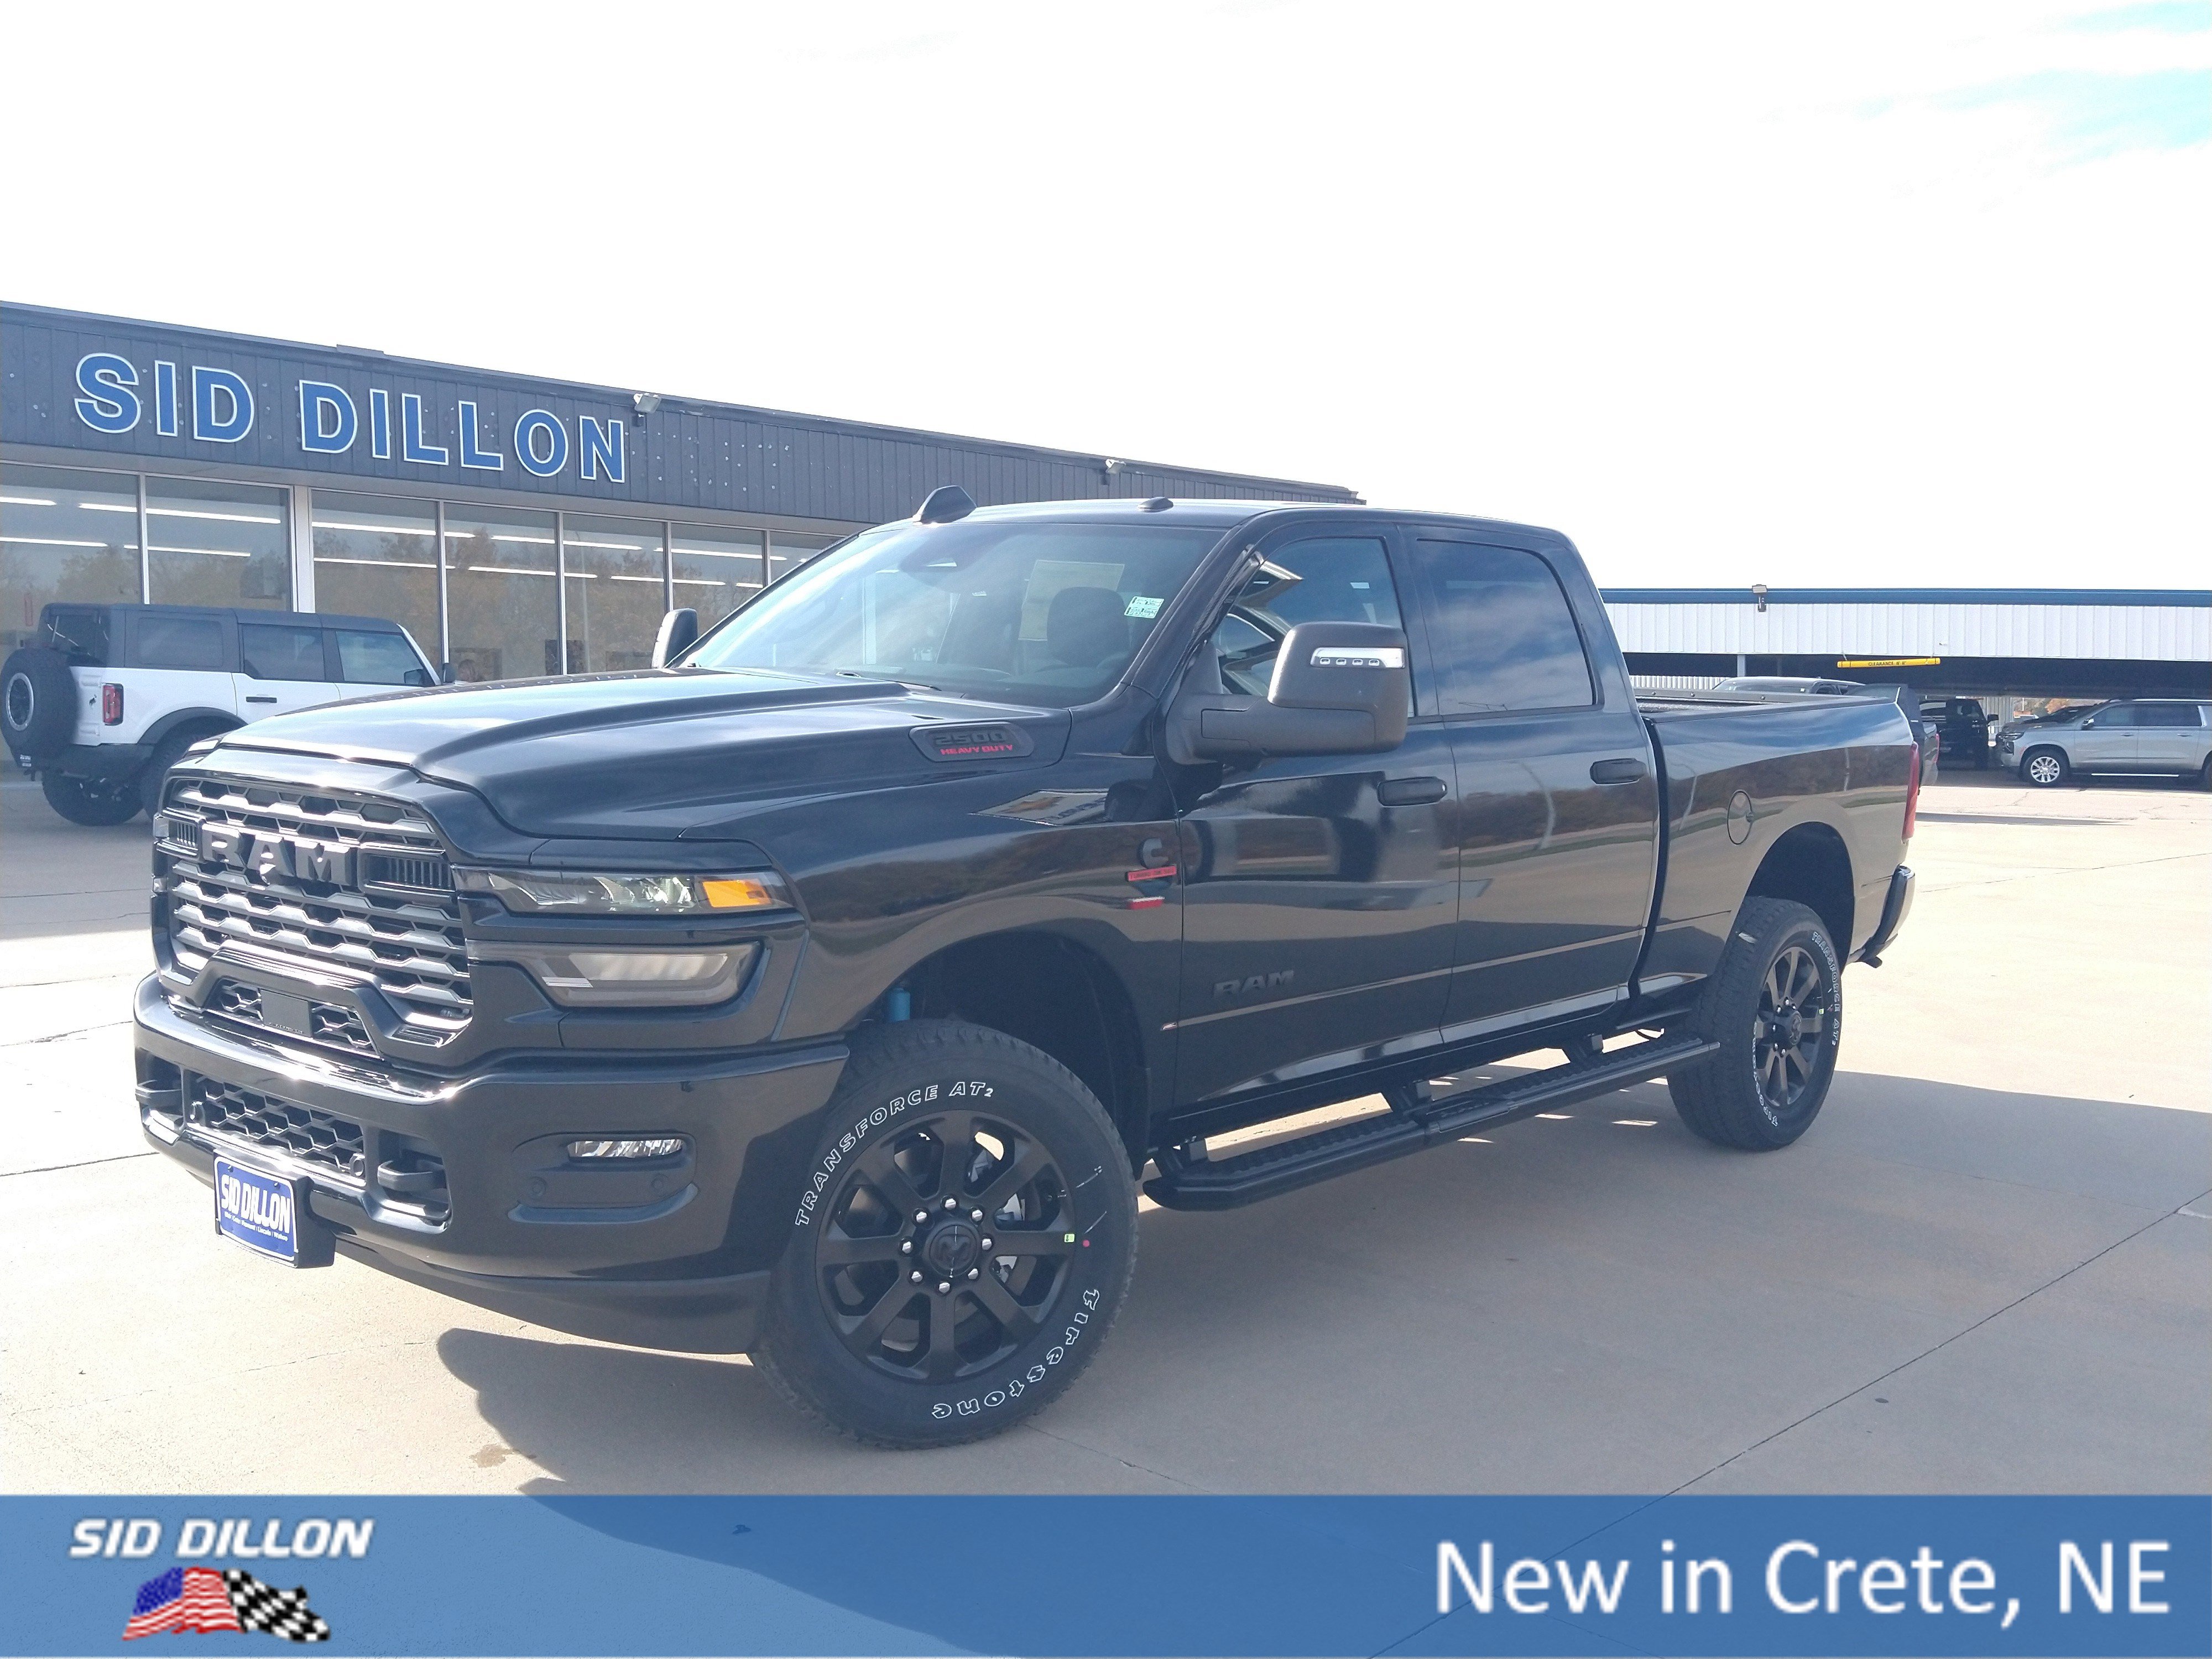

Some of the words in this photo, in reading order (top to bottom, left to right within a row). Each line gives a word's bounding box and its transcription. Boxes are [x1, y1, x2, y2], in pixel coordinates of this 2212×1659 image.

[74, 352, 254, 444] SID
[299, 379, 625, 484] DILLON
[935, 731, 1006, 745] 2500
[940, 745, 979, 755] HEAVY
[982, 744, 1013, 753] DUTY
[201, 823, 352, 886] RAM
[1213, 970, 1295, 998] RAM
[795, 1084, 938, 1227] TRANSFORCE
[221, 1174, 241, 1215] SID
[241, 1182, 290, 1234] DILLON
